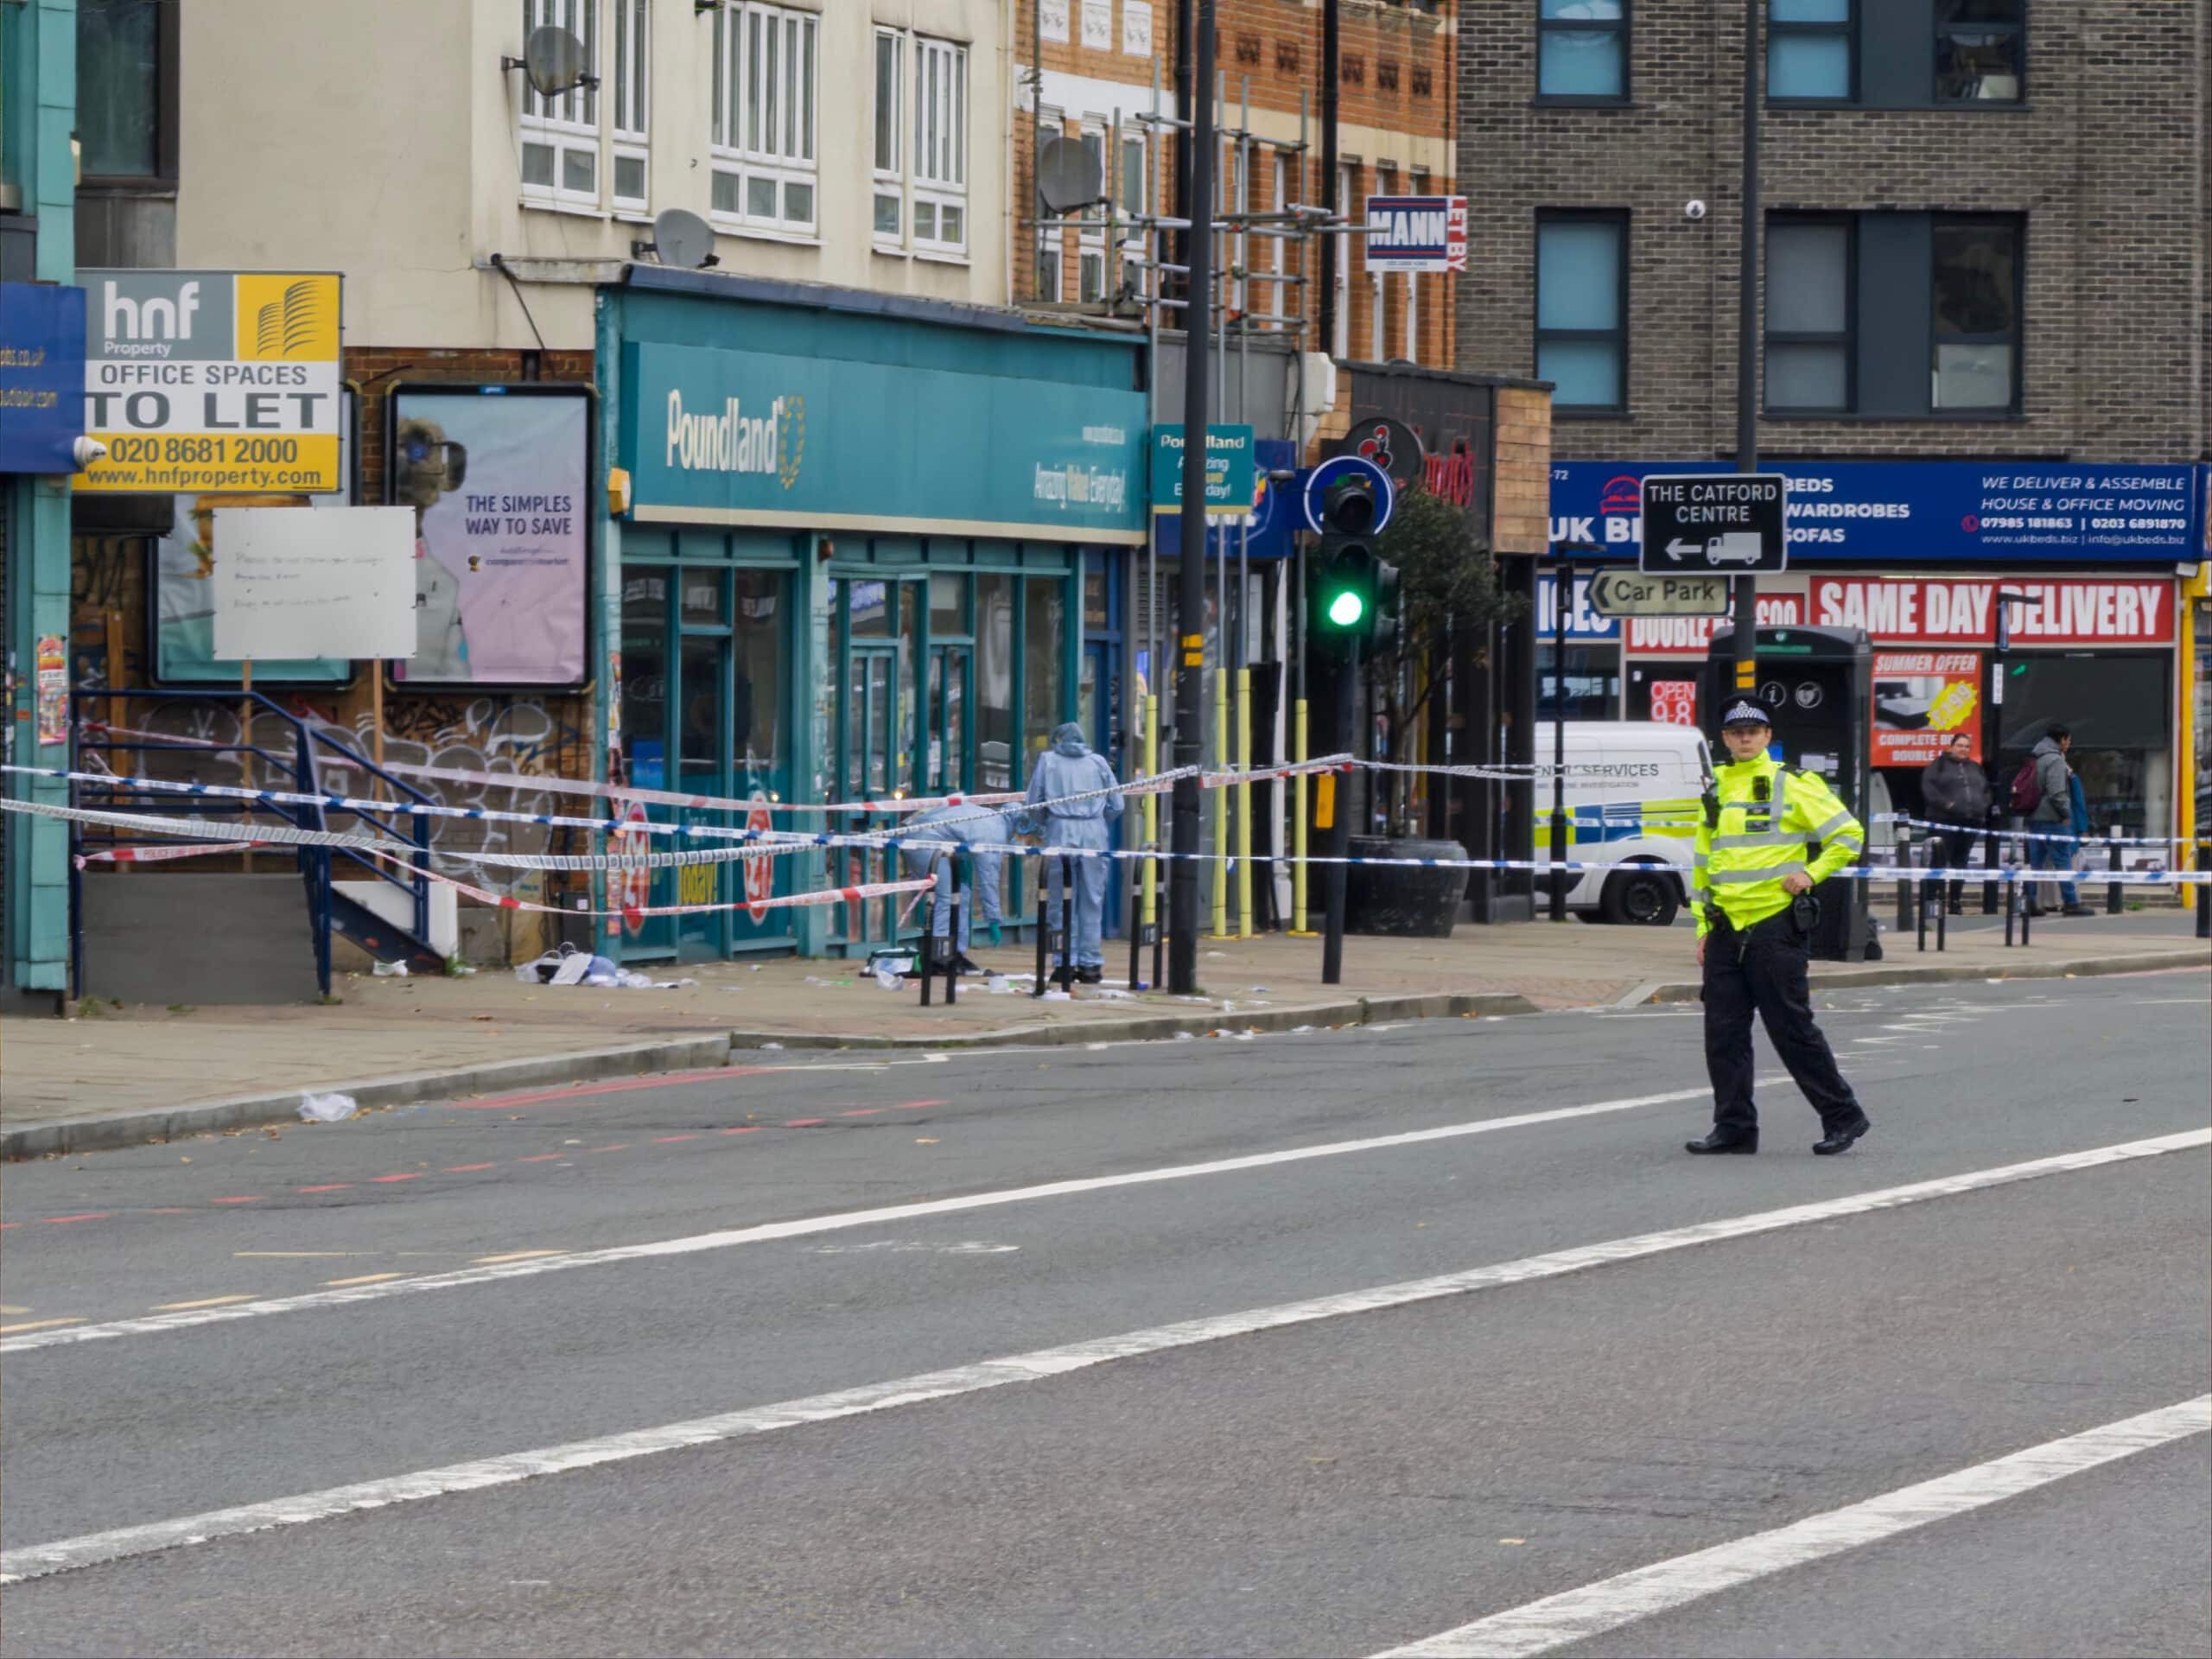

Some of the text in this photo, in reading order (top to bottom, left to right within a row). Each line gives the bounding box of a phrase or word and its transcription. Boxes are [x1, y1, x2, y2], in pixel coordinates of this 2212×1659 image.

[1369, 211, 1446, 246] MANN
[105, 281, 200, 340] hnf
[105, 340, 172, 357] Property
[100, 364, 307, 385] OFFICE SPACES
[86, 391, 170, 429] TO
[203, 392, 328, 429] LET
[666, 389, 781, 474] Poundland
[111, 438, 298, 463] 020 8681 2000
[1160, 435, 1245, 448] Poland
[88, 467, 321, 488] www.hnfproperty.com
[1785, 478, 1834, 493] BEDS
[1981, 476, 2185, 491] WE DELIVER & ASSEMBLE
[1649, 484, 1777, 502] THE CATFORD
[466, 495, 572, 512] THE SIMPLES
[1786, 503, 1910, 518] WARDROBES
[1980, 498, 2185, 512] HOUSE & OFFICE MOVING
[1675, 505, 1751, 523] CENTRE
[466, 518, 572, 535] WAY TO SAVE
[1548, 518, 1595, 543] UK
[2091, 518, 2126, 529] 0203
[1784, 528, 1846, 543] SOFAS
[1614, 579, 1715, 601] Car Park
[1820, 582, 2163, 635] SAME DAY DELIVERY
[1876, 655, 1978, 671] SUMMER OFFER
[1650, 682, 1696, 702] OPEN
[1582, 764, 1659, 777] SERVICES
